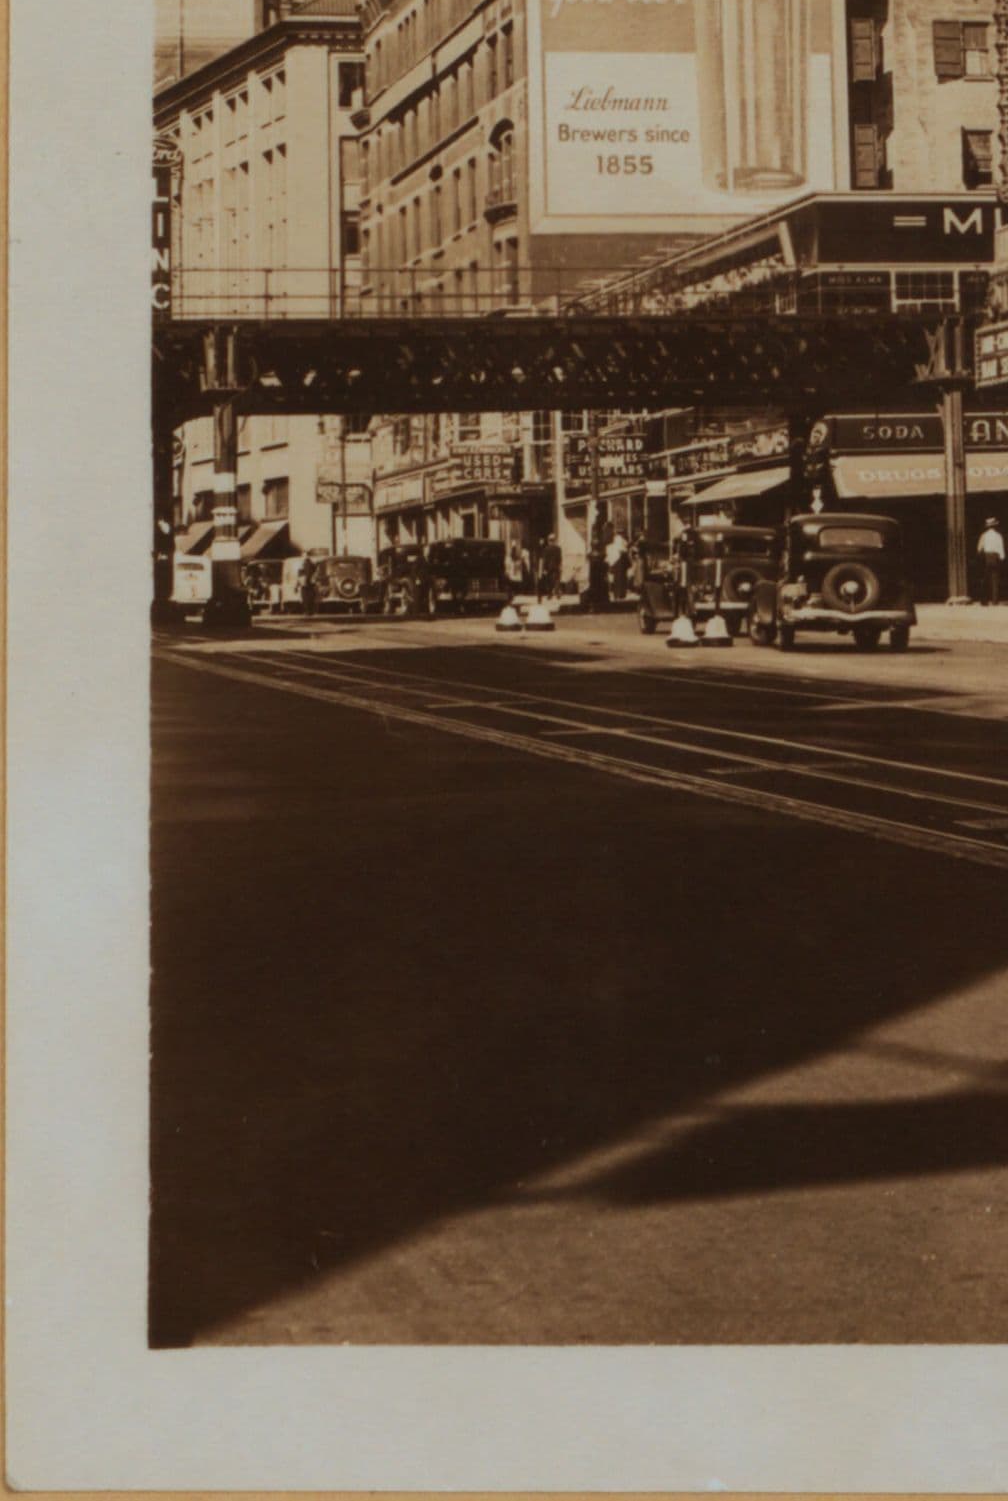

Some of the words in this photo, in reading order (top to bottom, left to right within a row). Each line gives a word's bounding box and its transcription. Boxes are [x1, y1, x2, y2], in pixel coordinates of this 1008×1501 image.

[563, 87, 671, 112] Liebmann
[557, 124, 638, 143] Brewers
[644, 124, 691, 143] since
[595, 155, 654, 176] 1855
[863, 425, 924, 440] SODA
[578, 437, 644, 451] PCKARD
[463, 455, 500, 467] USED
[463, 467, 501, 479] CARS
[579, 465, 610, 477] USD
